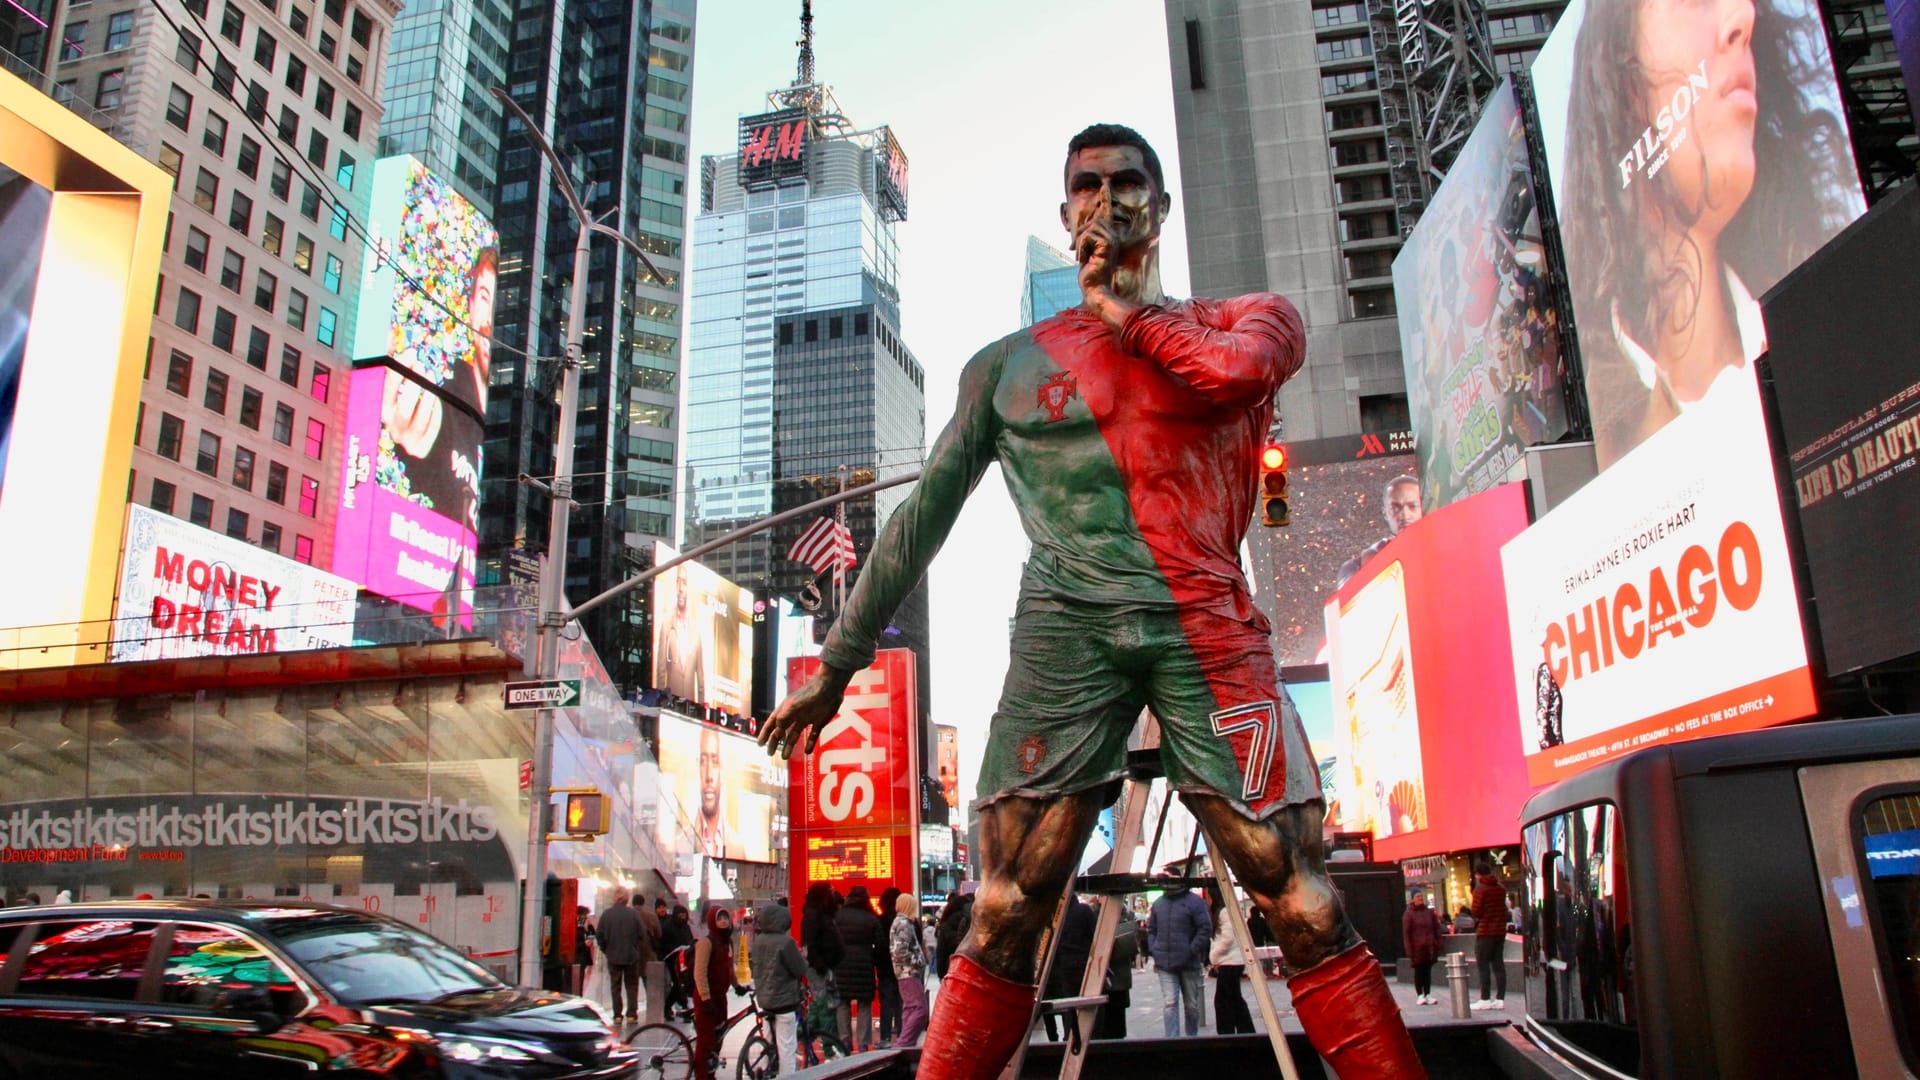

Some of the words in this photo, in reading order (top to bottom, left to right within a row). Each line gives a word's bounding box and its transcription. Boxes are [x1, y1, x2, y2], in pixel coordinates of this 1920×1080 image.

[743, 119, 805, 167] H&M
[1618, 59, 1710, 189] FILSON
[1796, 464, 1833, 508] LIFE
[1832, 454, 1852, 489] IS
[1874, 469, 1894, 482] YORK
[1894, 457, 1917, 473] TIMES
[1565, 569, 1590, 594] ERIKA
[1592, 549, 1620, 579] JAYNE
[1622, 543, 1631, 560] IS
[1633, 523, 1664, 554] ROXIE
[1666, 503, 1697, 534] HART
[154, 546, 281, 612] MONEY
[314, 580, 349, 600] PETER
[151, 596, 278, 653] DREAM
[754, 614, 765, 622] LG
[1544, 521, 1763, 690] CHICAGO
[515, 690, 537, 701] ONE
[546, 688, 569, 699] WAY
[1674, 723, 1685, 733] NO
[1686, 718, 1700, 729] FEES
[1701, 714, 1709, 725] AT
[1710, 710, 1722, 722] THE
[1724, 706, 1738, 719] BOX
[1739, 698, 1764, 714] OFFICE
[1209, 700, 1278, 800] 7
[1, 845, 90, 865] Development
[93, 843, 128, 862] Fund
[362, 895, 380, 912] 10
[423, 896, 437, 912] 11
